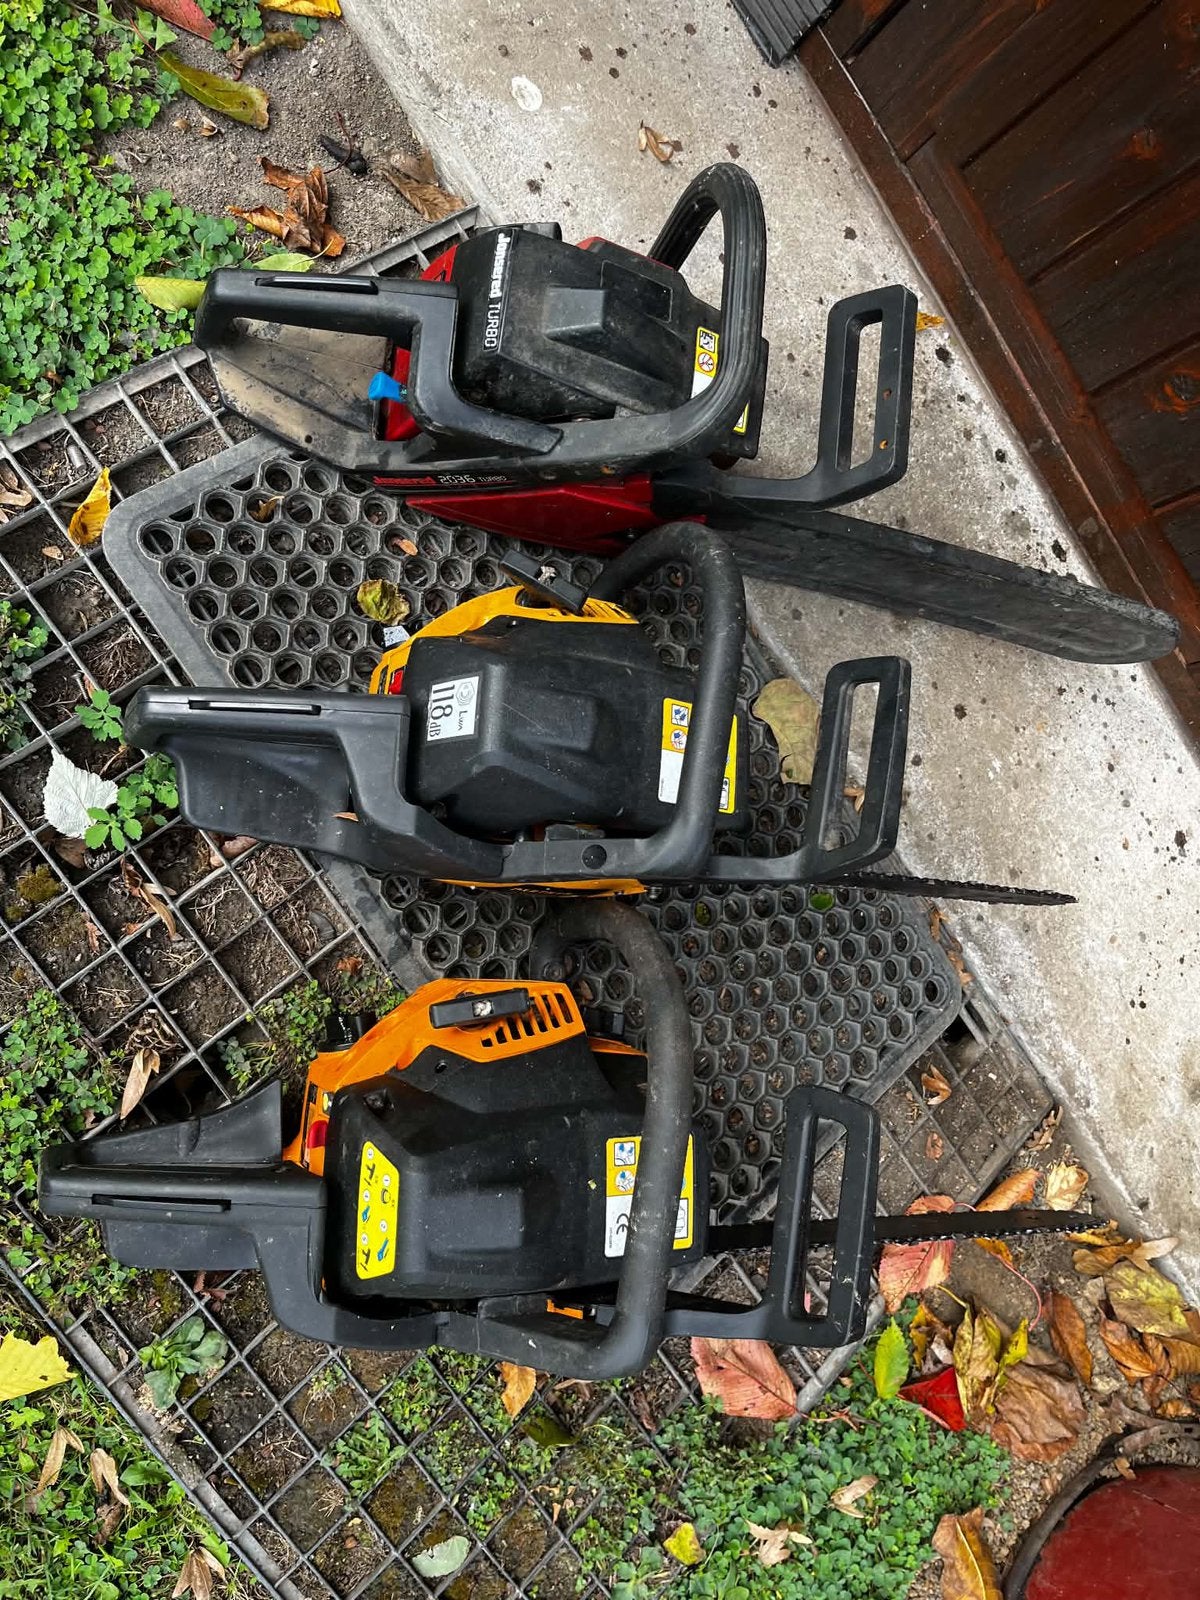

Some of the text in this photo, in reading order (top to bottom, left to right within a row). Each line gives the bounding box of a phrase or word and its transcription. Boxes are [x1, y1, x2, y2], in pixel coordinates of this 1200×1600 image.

[484, 232, 511, 347] Jonsered TURBO
[438, 474, 476, 484] 2036
[429, 684, 455, 737] 118 dB
[616, 1213, 630, 1235] CE
